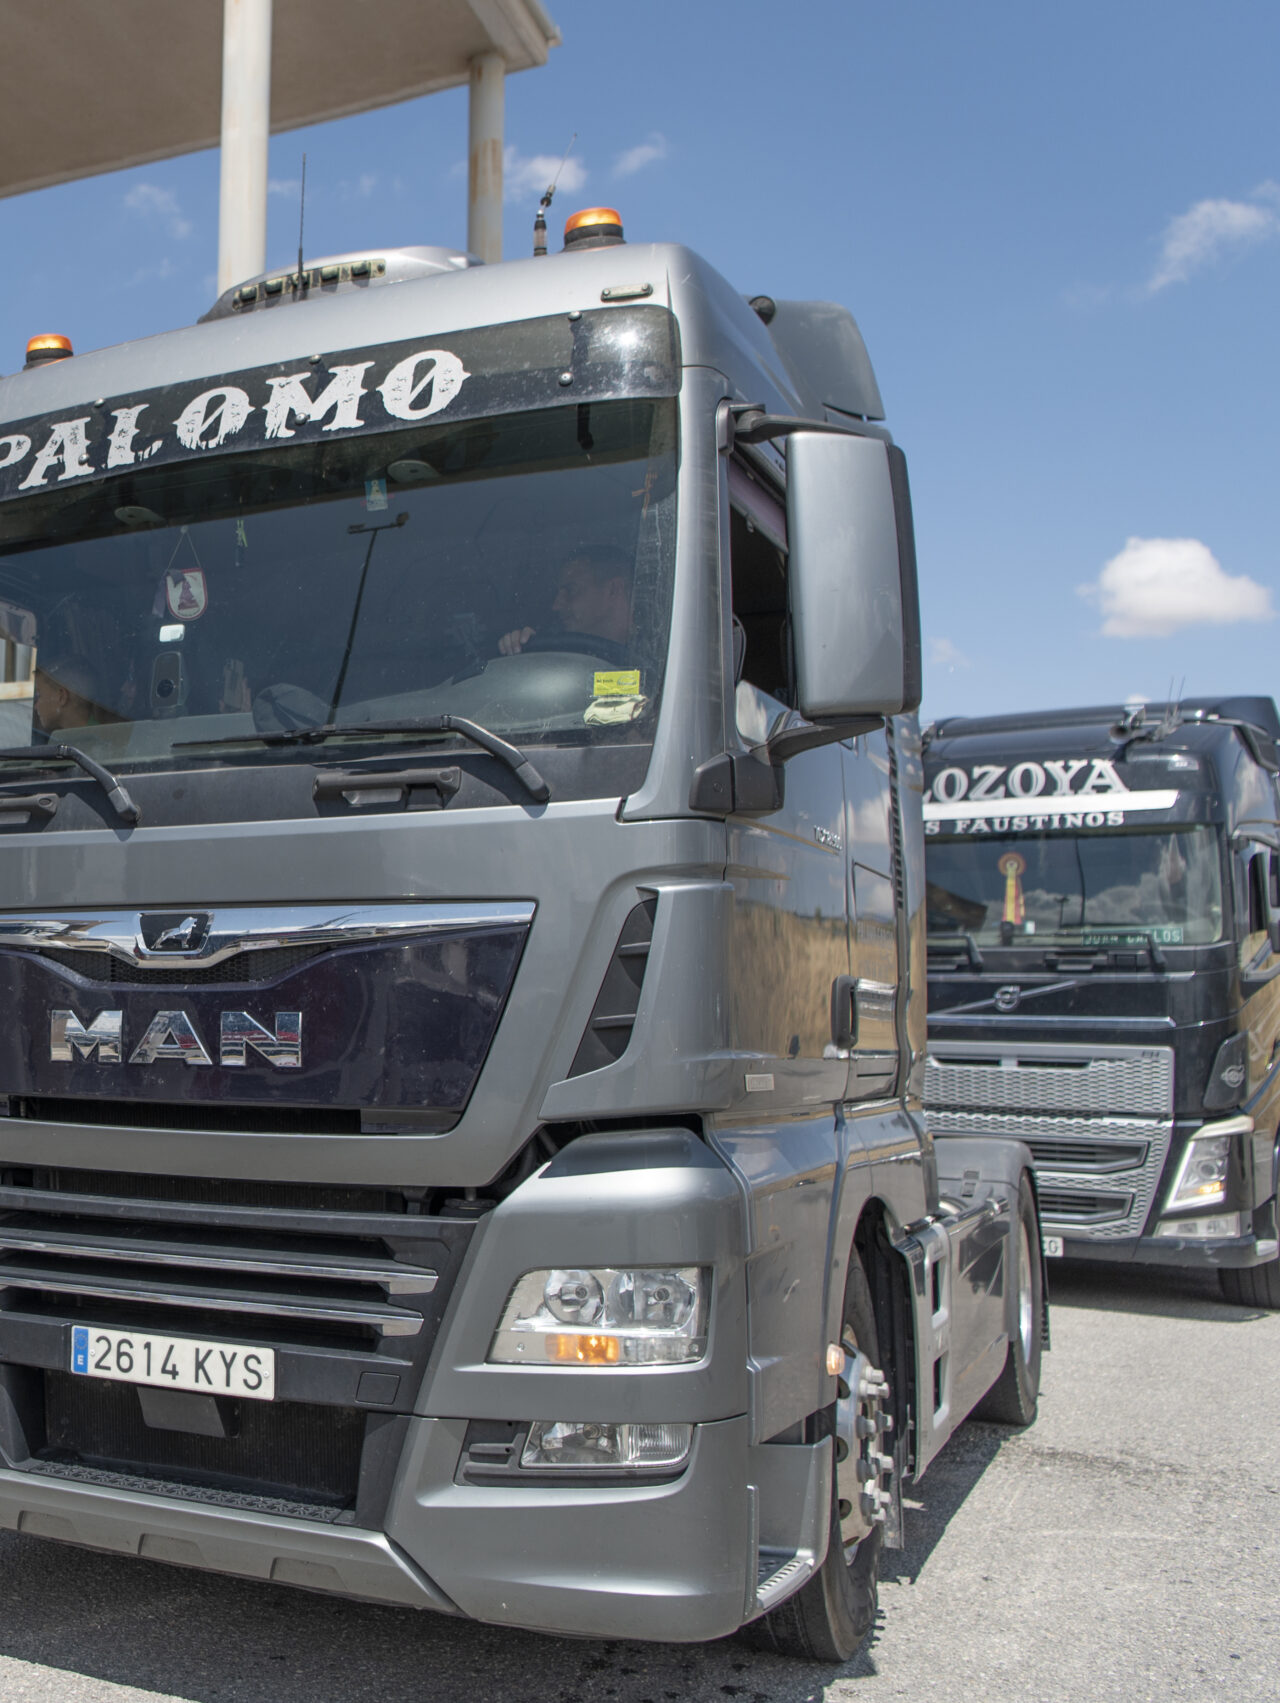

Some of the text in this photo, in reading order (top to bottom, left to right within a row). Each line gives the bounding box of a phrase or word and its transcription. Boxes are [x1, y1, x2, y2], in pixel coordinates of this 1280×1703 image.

[923, 758, 1130, 804] OZOYA
[924, 810, 1125, 835] S FAUSTINOS
[50, 1009, 302, 1068] MAN
[77, 1354, 85, 1366] E
[93, 1335, 263, 1391] 2614 KYS
